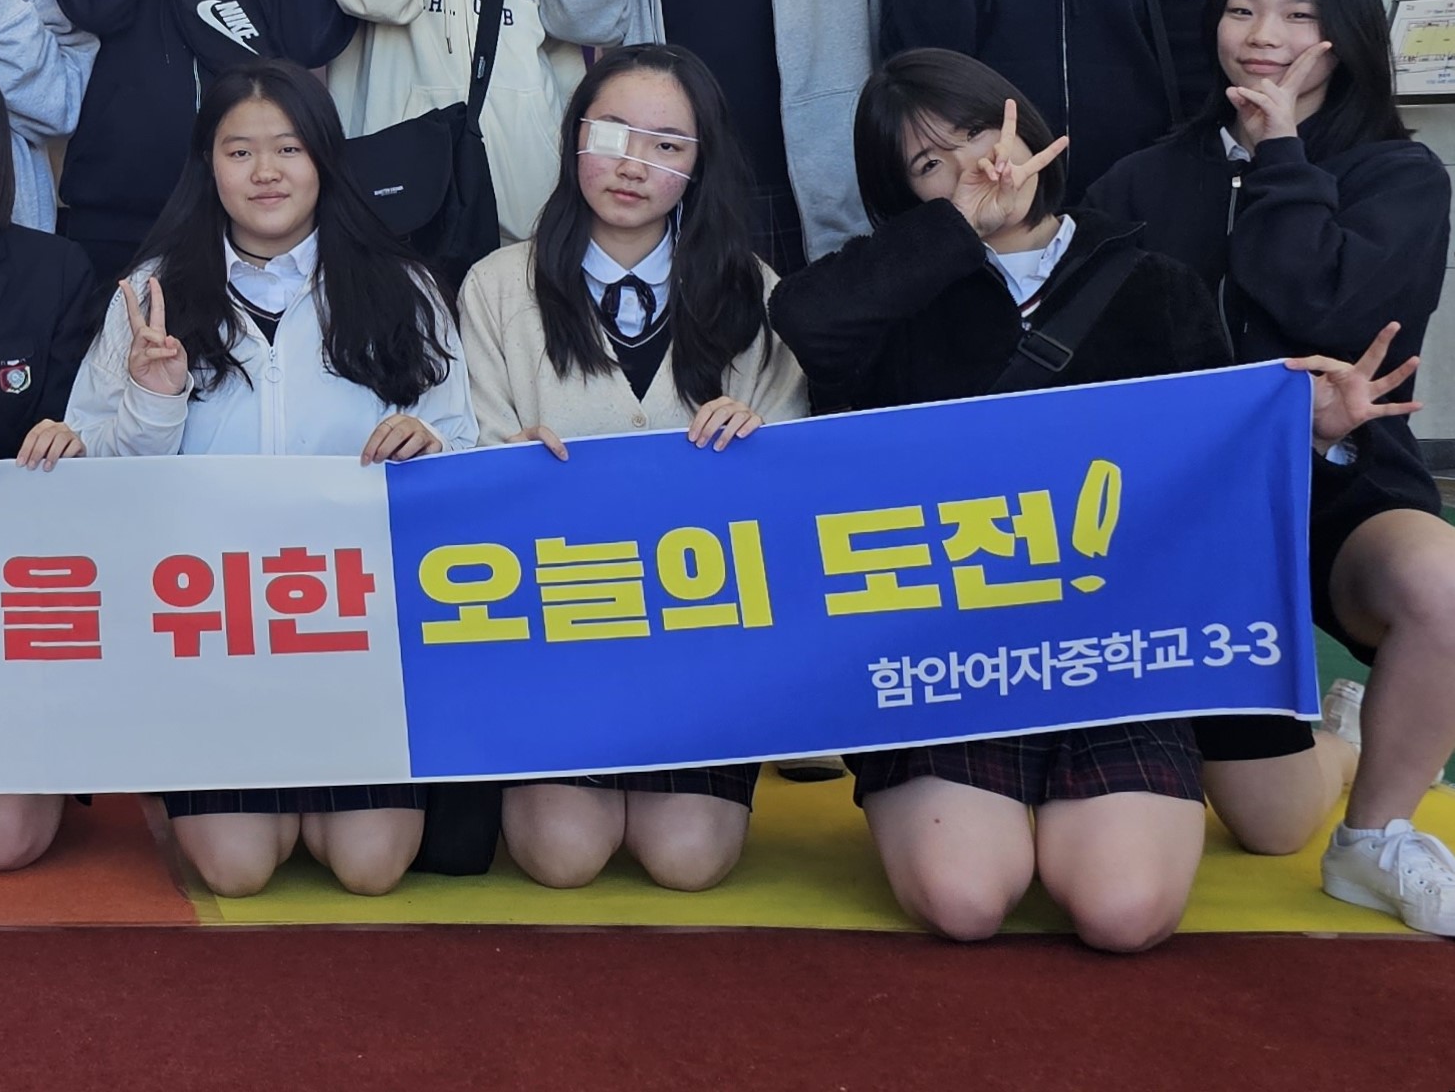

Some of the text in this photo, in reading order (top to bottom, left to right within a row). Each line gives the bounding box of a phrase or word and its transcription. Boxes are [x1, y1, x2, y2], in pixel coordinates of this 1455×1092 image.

[214, 0, 260, 41] NIKE
[152, 546, 376, 658] 위한
[418, 519, 773, 645] 오늘의
[815, 458, 1122, 617] 도전!
[867, 621, 1282, 709] 함안여자중학교 3-3
